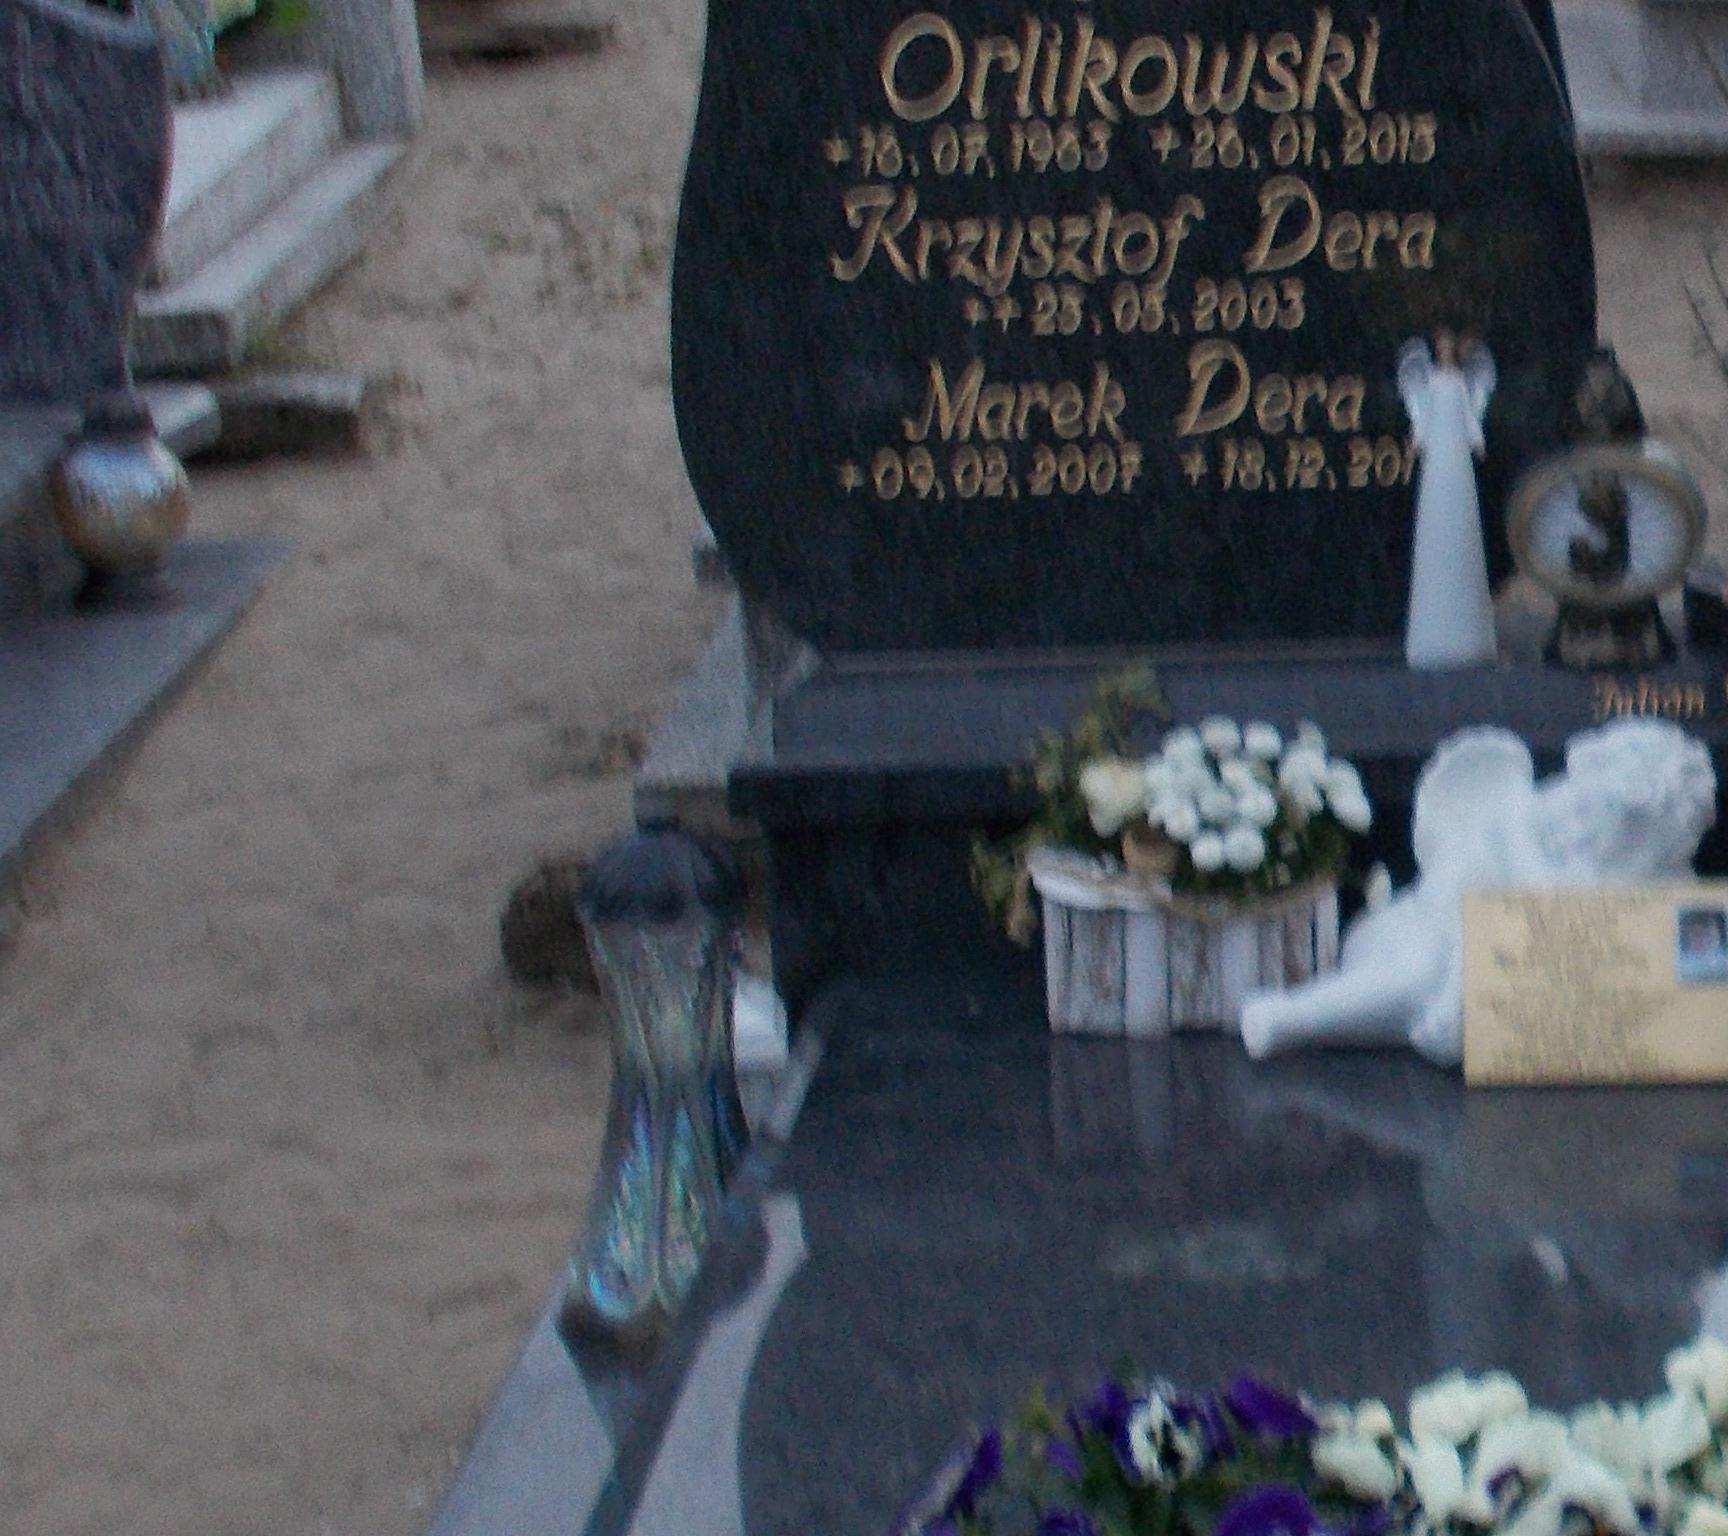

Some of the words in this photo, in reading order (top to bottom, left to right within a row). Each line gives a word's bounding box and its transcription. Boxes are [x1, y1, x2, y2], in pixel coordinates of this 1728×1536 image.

[879, 6, 1380, 124] Orlikowski
[831, 182, 1207, 297] Krzysztof
[1246, 175, 1437, 272] Dera
[902, 358, 1127, 444] Marek
[1177, 340, 1365, 436] Dera
[1220, 433, 1413, 491] 18.12.201
